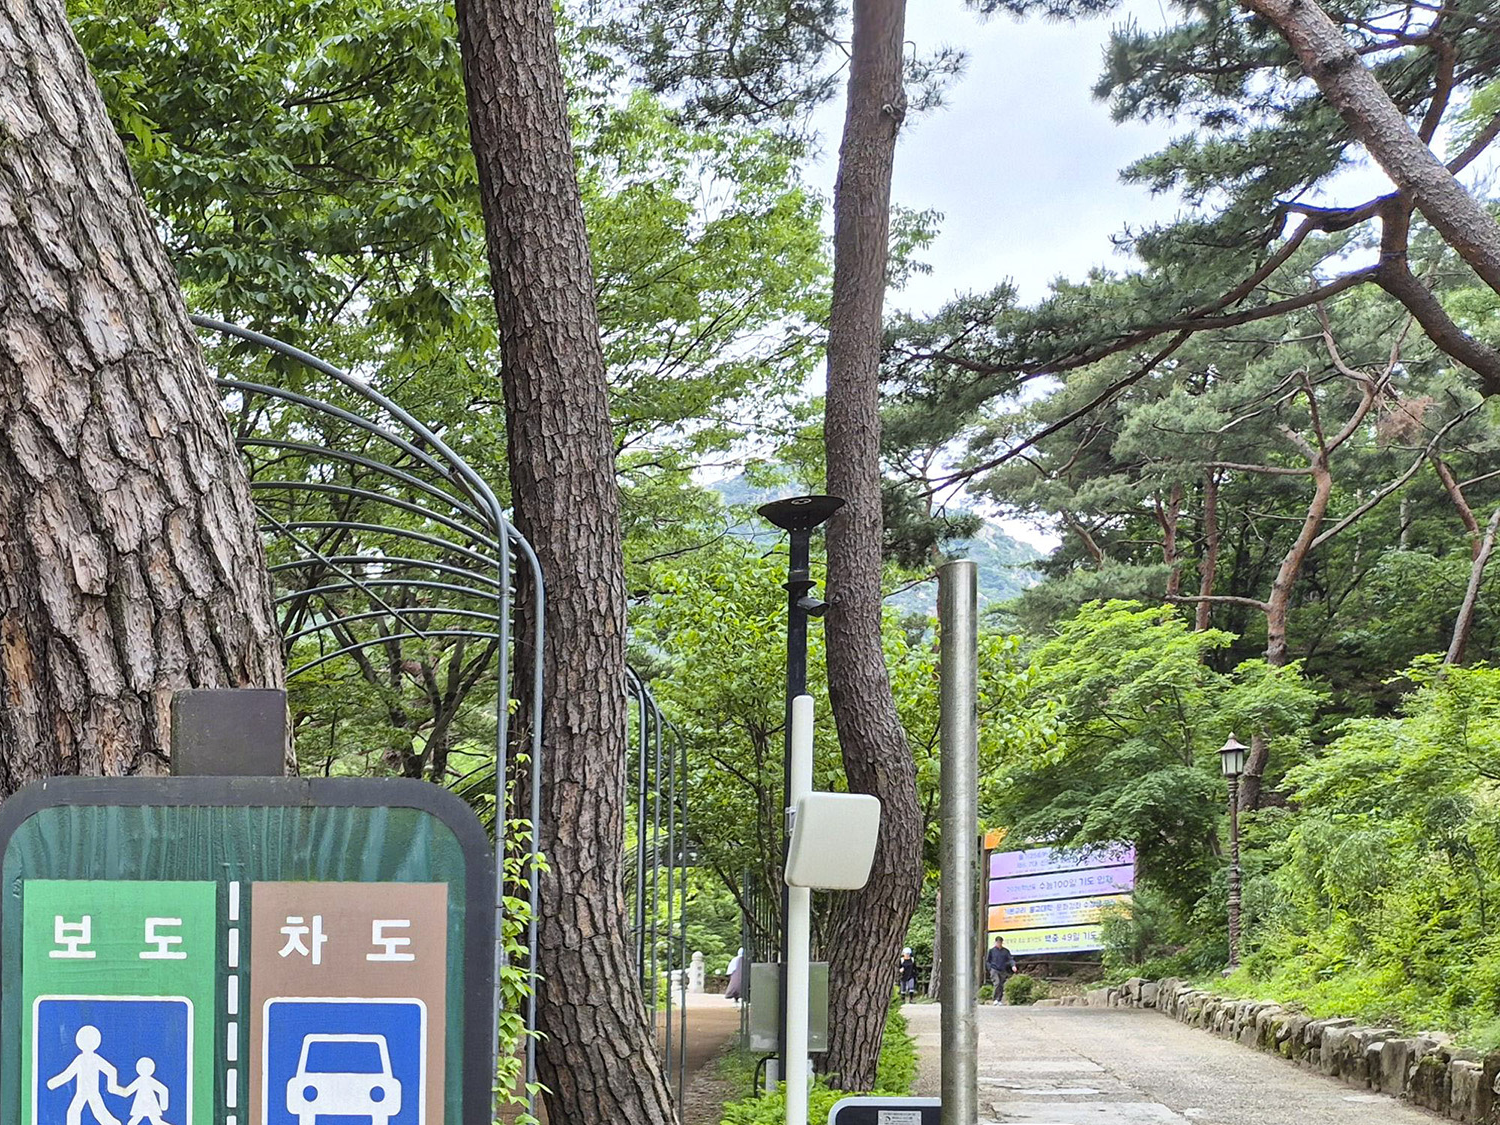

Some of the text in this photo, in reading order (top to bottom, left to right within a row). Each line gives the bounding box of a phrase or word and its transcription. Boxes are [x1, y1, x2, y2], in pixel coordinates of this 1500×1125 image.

[1039, 878, 1077, 889] 수능100일
[1079, 877, 1094, 886] 기도
[1044, 934, 1059, 943] 백중
[1061, 932, 1080, 943] 49일
